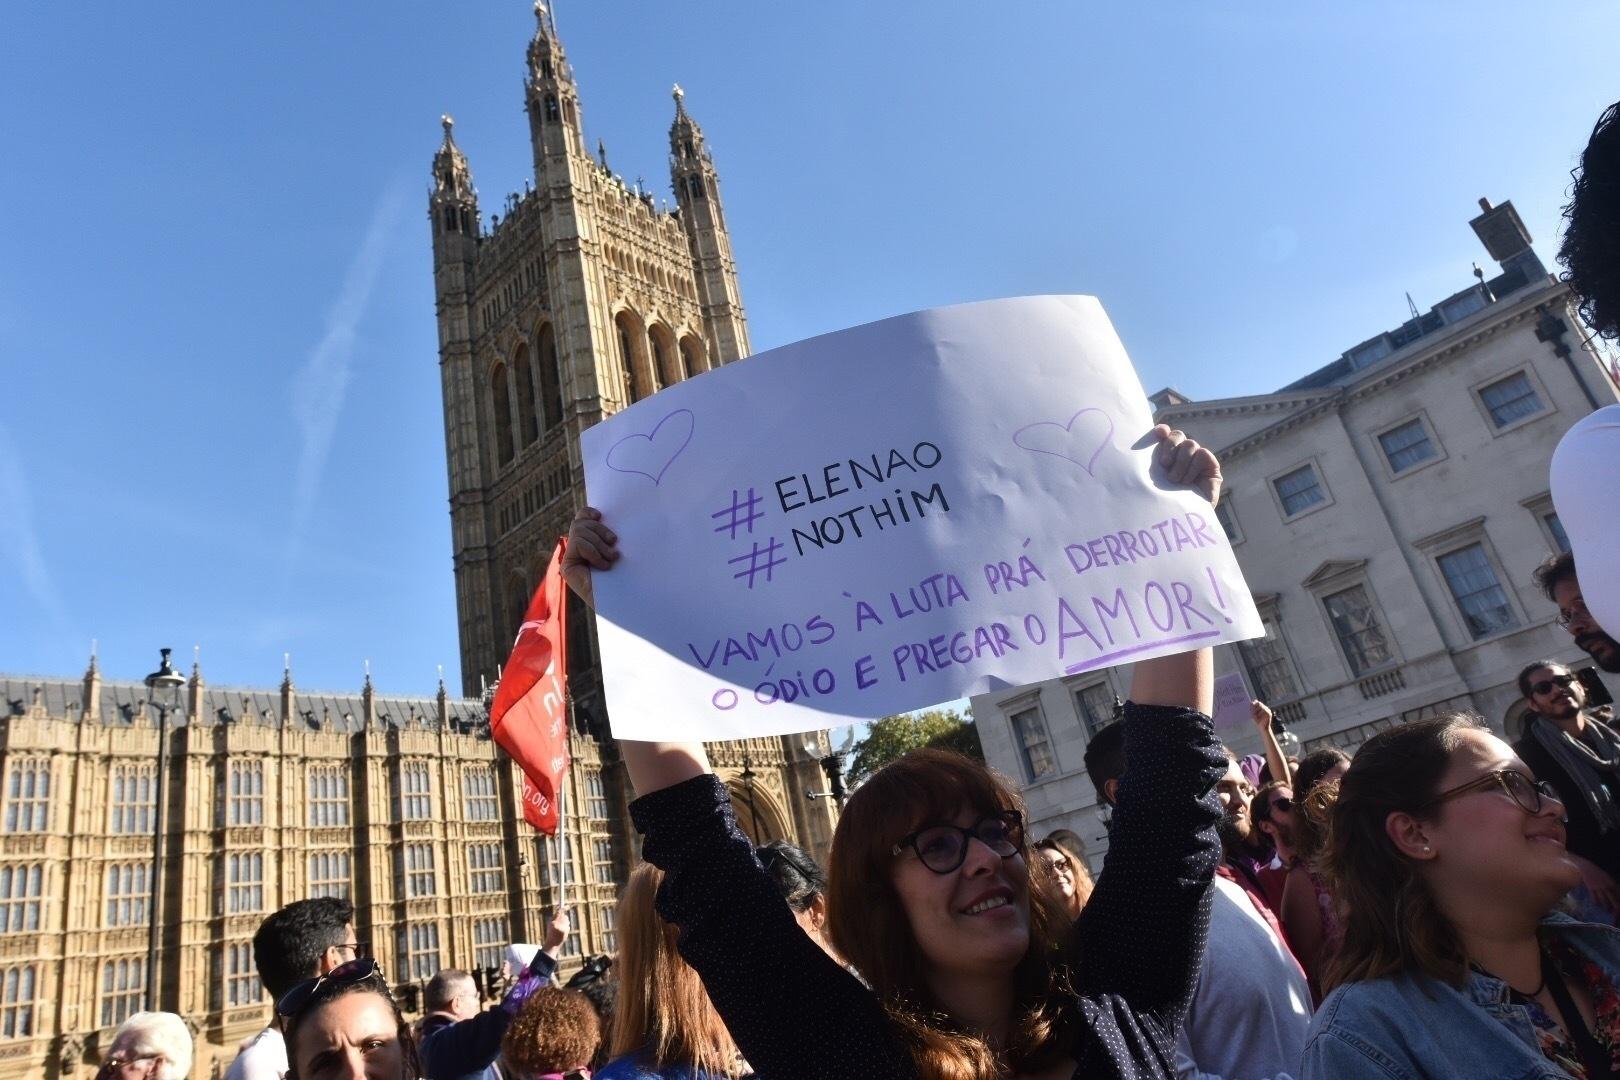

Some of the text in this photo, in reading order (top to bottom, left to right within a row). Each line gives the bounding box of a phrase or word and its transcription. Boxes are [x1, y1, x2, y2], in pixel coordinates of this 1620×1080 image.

[687, 511, 1218, 669] VAMOS À LUTA PRÁ DERROTAR
[711, 688, 739, 711] O
[854, 654, 879, 690] E
[892, 621, 1019, 682] PREGAR
[1023, 613, 1047, 646] O
[1057, 566, 1233, 660] AMOR!
